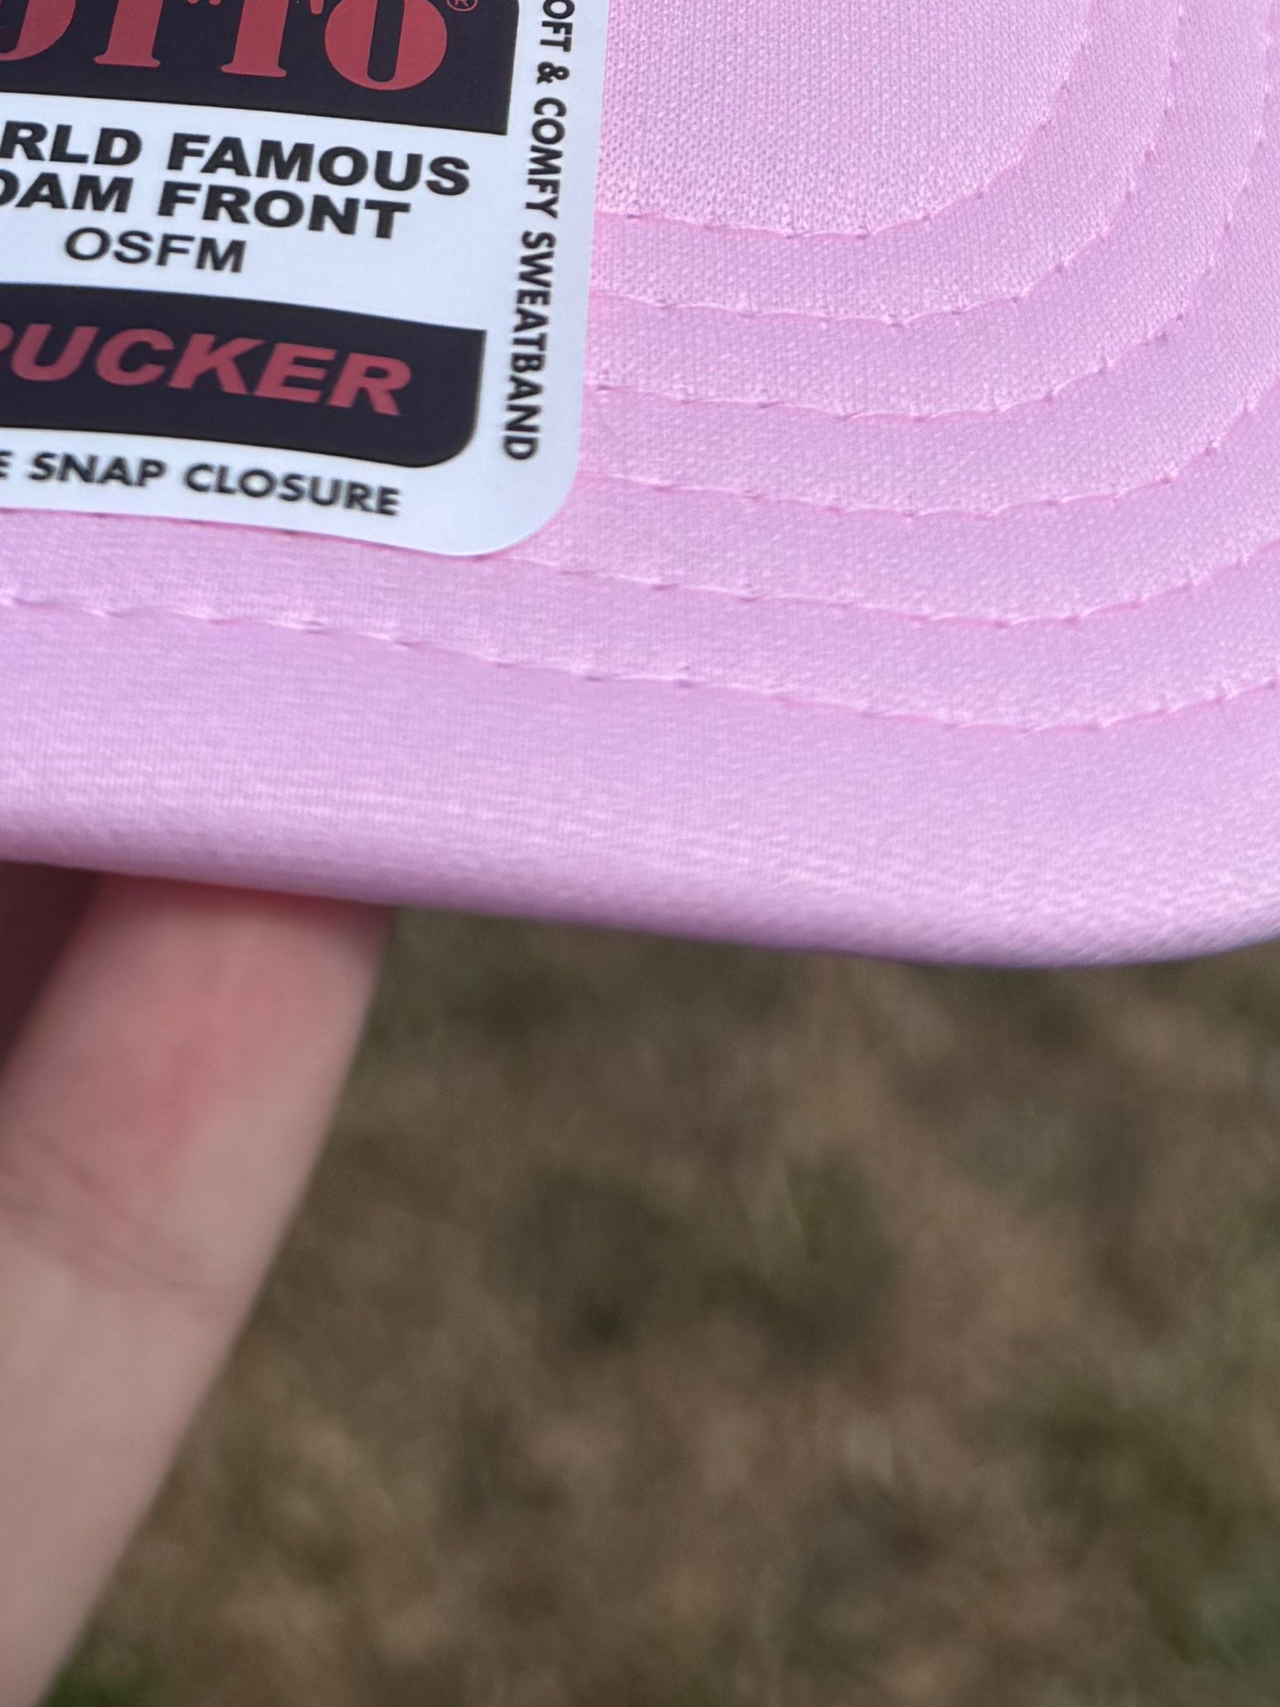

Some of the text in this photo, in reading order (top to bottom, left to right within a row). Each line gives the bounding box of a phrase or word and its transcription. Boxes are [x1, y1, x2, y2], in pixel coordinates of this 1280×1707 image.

[536, 61, 570, 85] &
[168, 133, 470, 196] FAMOUS
[528, 97, 567, 219] COMFY
[157, 182, 410, 239] FRONT
[64, 228, 245, 274] OSFM
[502, 231, 556, 461] SWEATBAND
[28, 452, 165, 489] SNAP
[185, 463, 401, 516] CLOSURE
